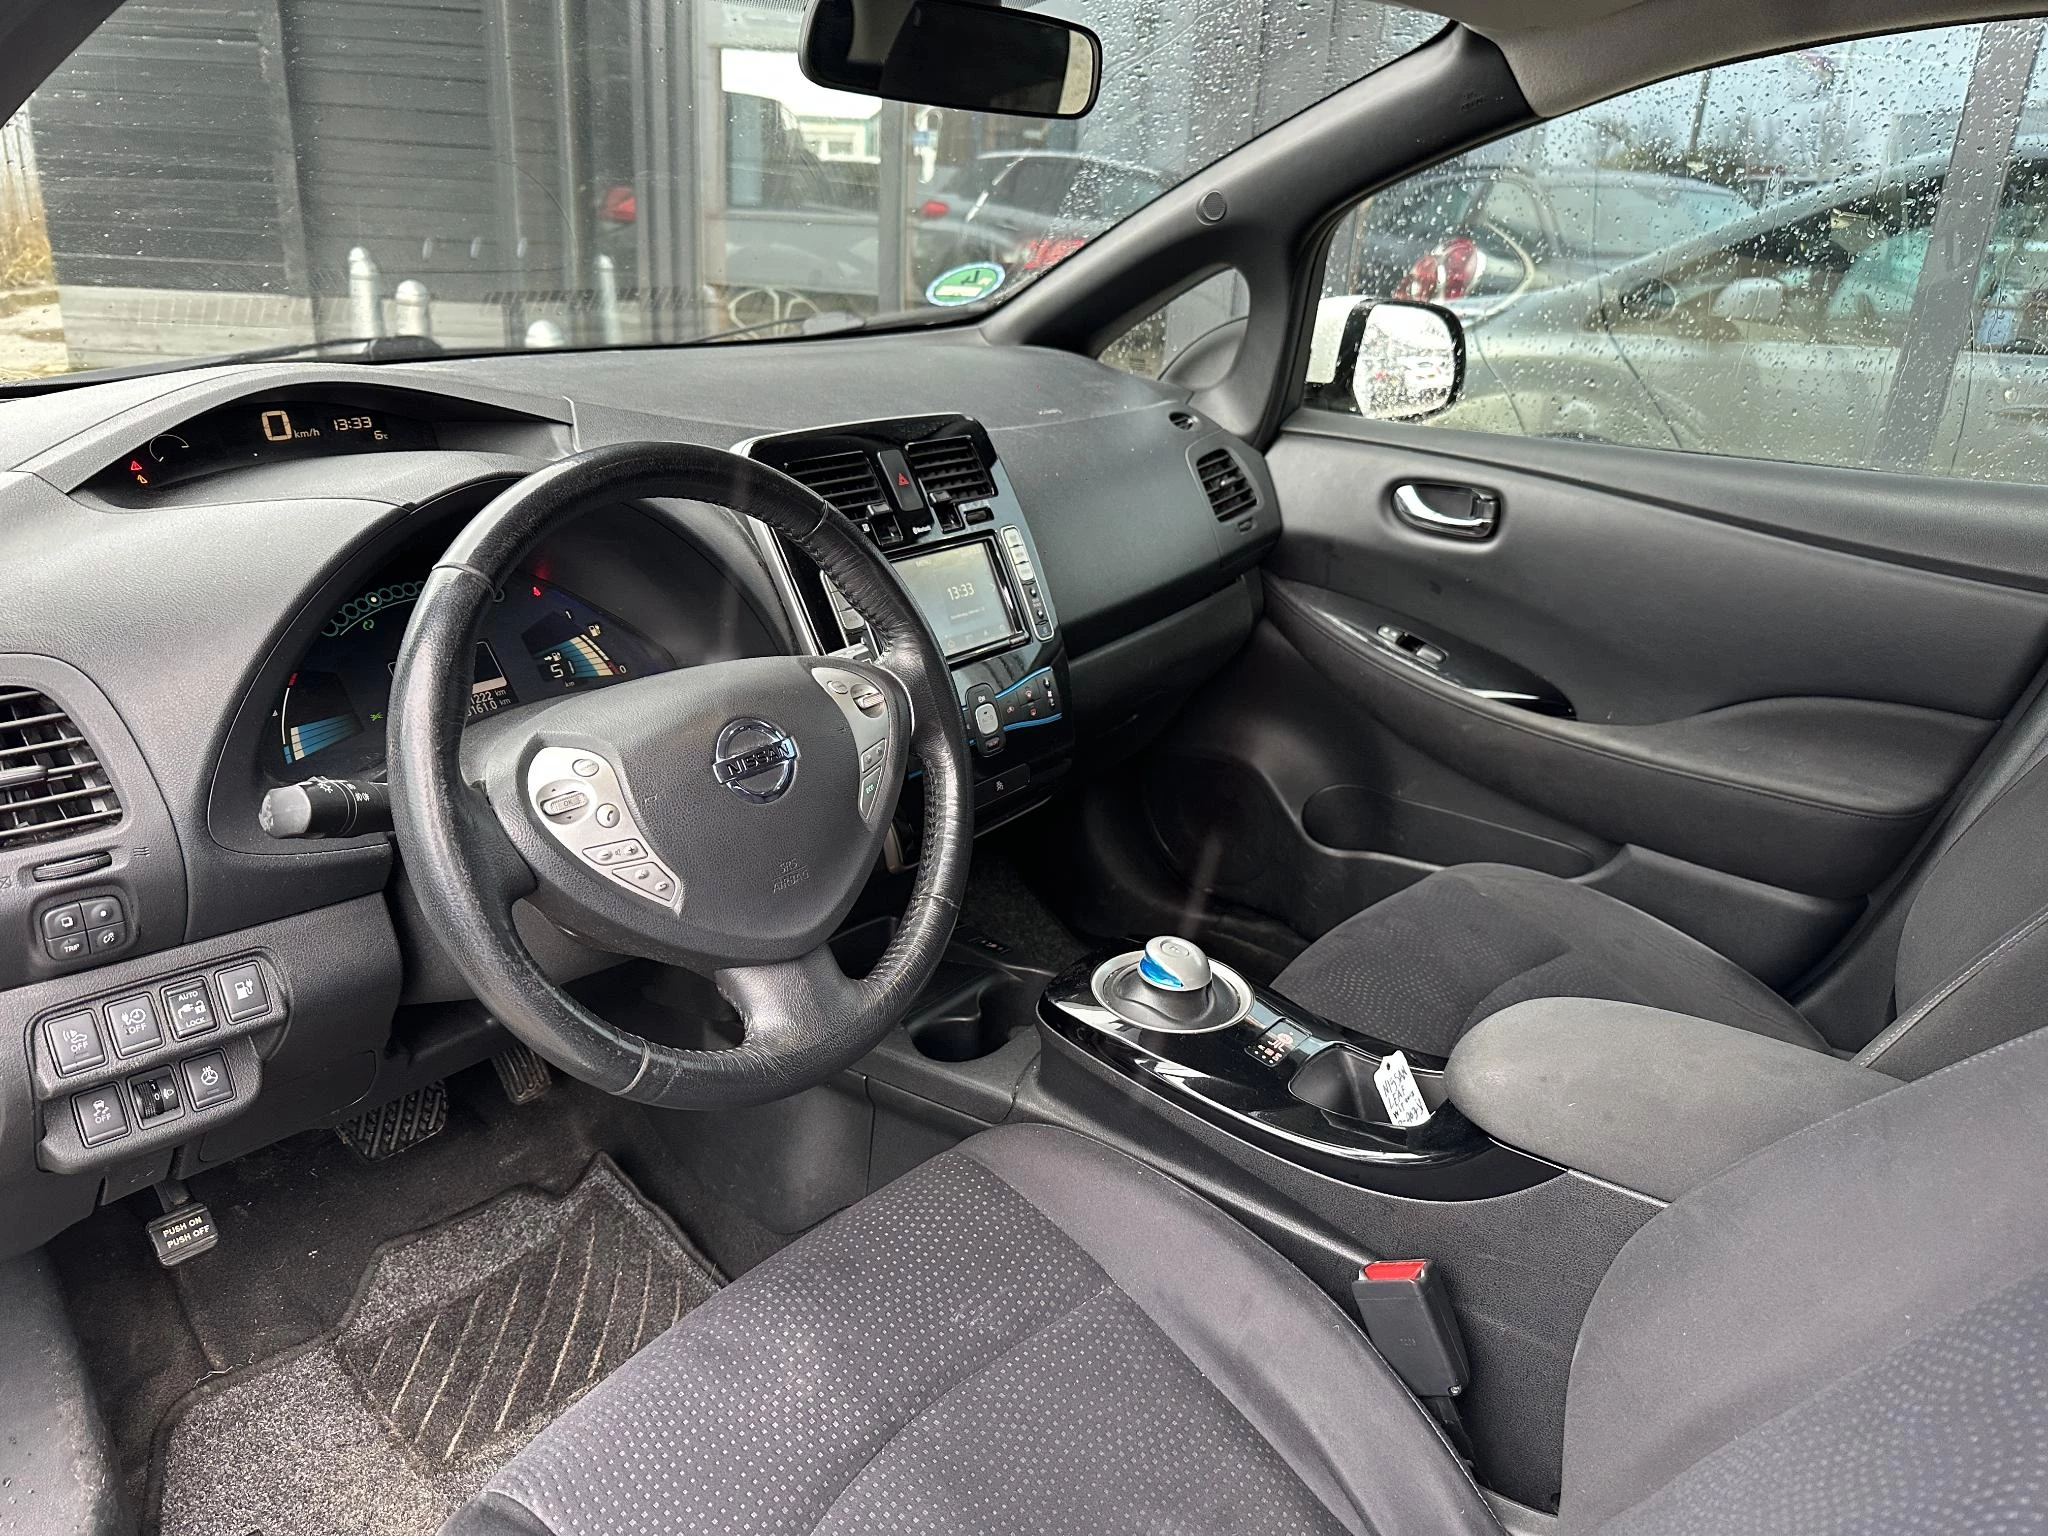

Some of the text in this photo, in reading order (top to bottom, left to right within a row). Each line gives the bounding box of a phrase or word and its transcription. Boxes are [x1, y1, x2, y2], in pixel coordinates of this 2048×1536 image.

[261, 410, 320, 441] 0 km/h
[334, 416, 372, 431] 13:33
[946, 582, 975, 600] 13:33
[494, 689, 506, 697] km
[500, 698, 511, 706] km
[727, 742, 790, 776] NISSAN
[563, 797, 573, 807] OK
[64, 943, 80, 953] TRIP
[178, 990, 199, 1001] AUTO
[128, 1022, 147, 1035] OFF
[185, 1017, 206, 1028] LOCK
[70, 1041, 89, 1053] OFF
[1387, 1085, 1405, 1110] LEAF
[95, 1113, 112, 1124] OFF
[162, 1216, 203, 1238] PUSH ON
[166, 1224, 210, 1249] PUSH OFF
